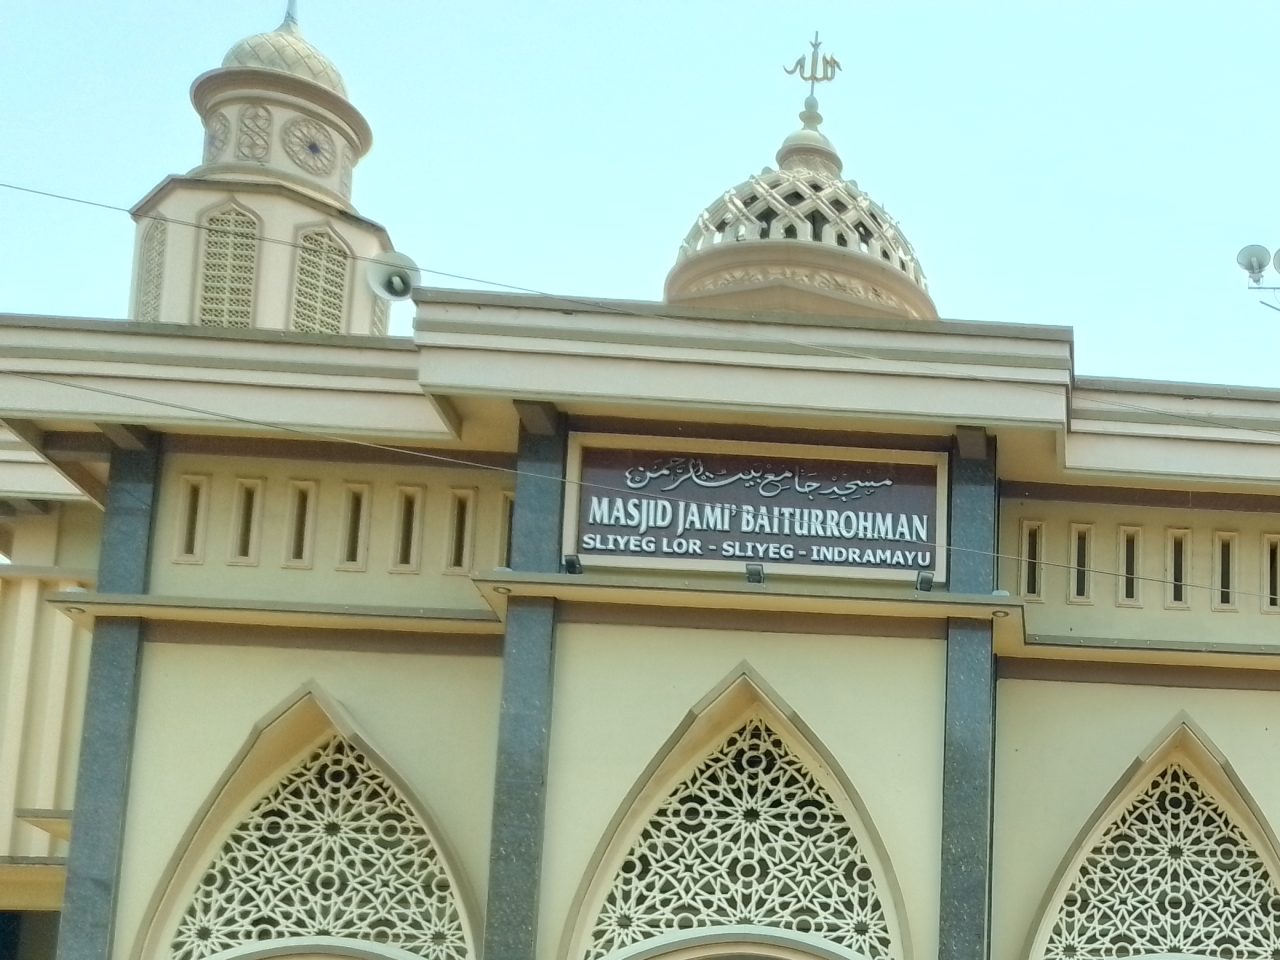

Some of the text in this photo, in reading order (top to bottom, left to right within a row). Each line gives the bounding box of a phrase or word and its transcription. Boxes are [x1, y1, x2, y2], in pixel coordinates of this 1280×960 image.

[588, 496, 673, 535] MASJID
[741, 504, 928, 543] BAITURROHMAN
[582, 533, 656, 553] SLIYEG
[662, 537, 703, 555] LOR
[722, 540, 794, 560] SLIYEG
[811, 545, 931, 567] INDRAMAYU
